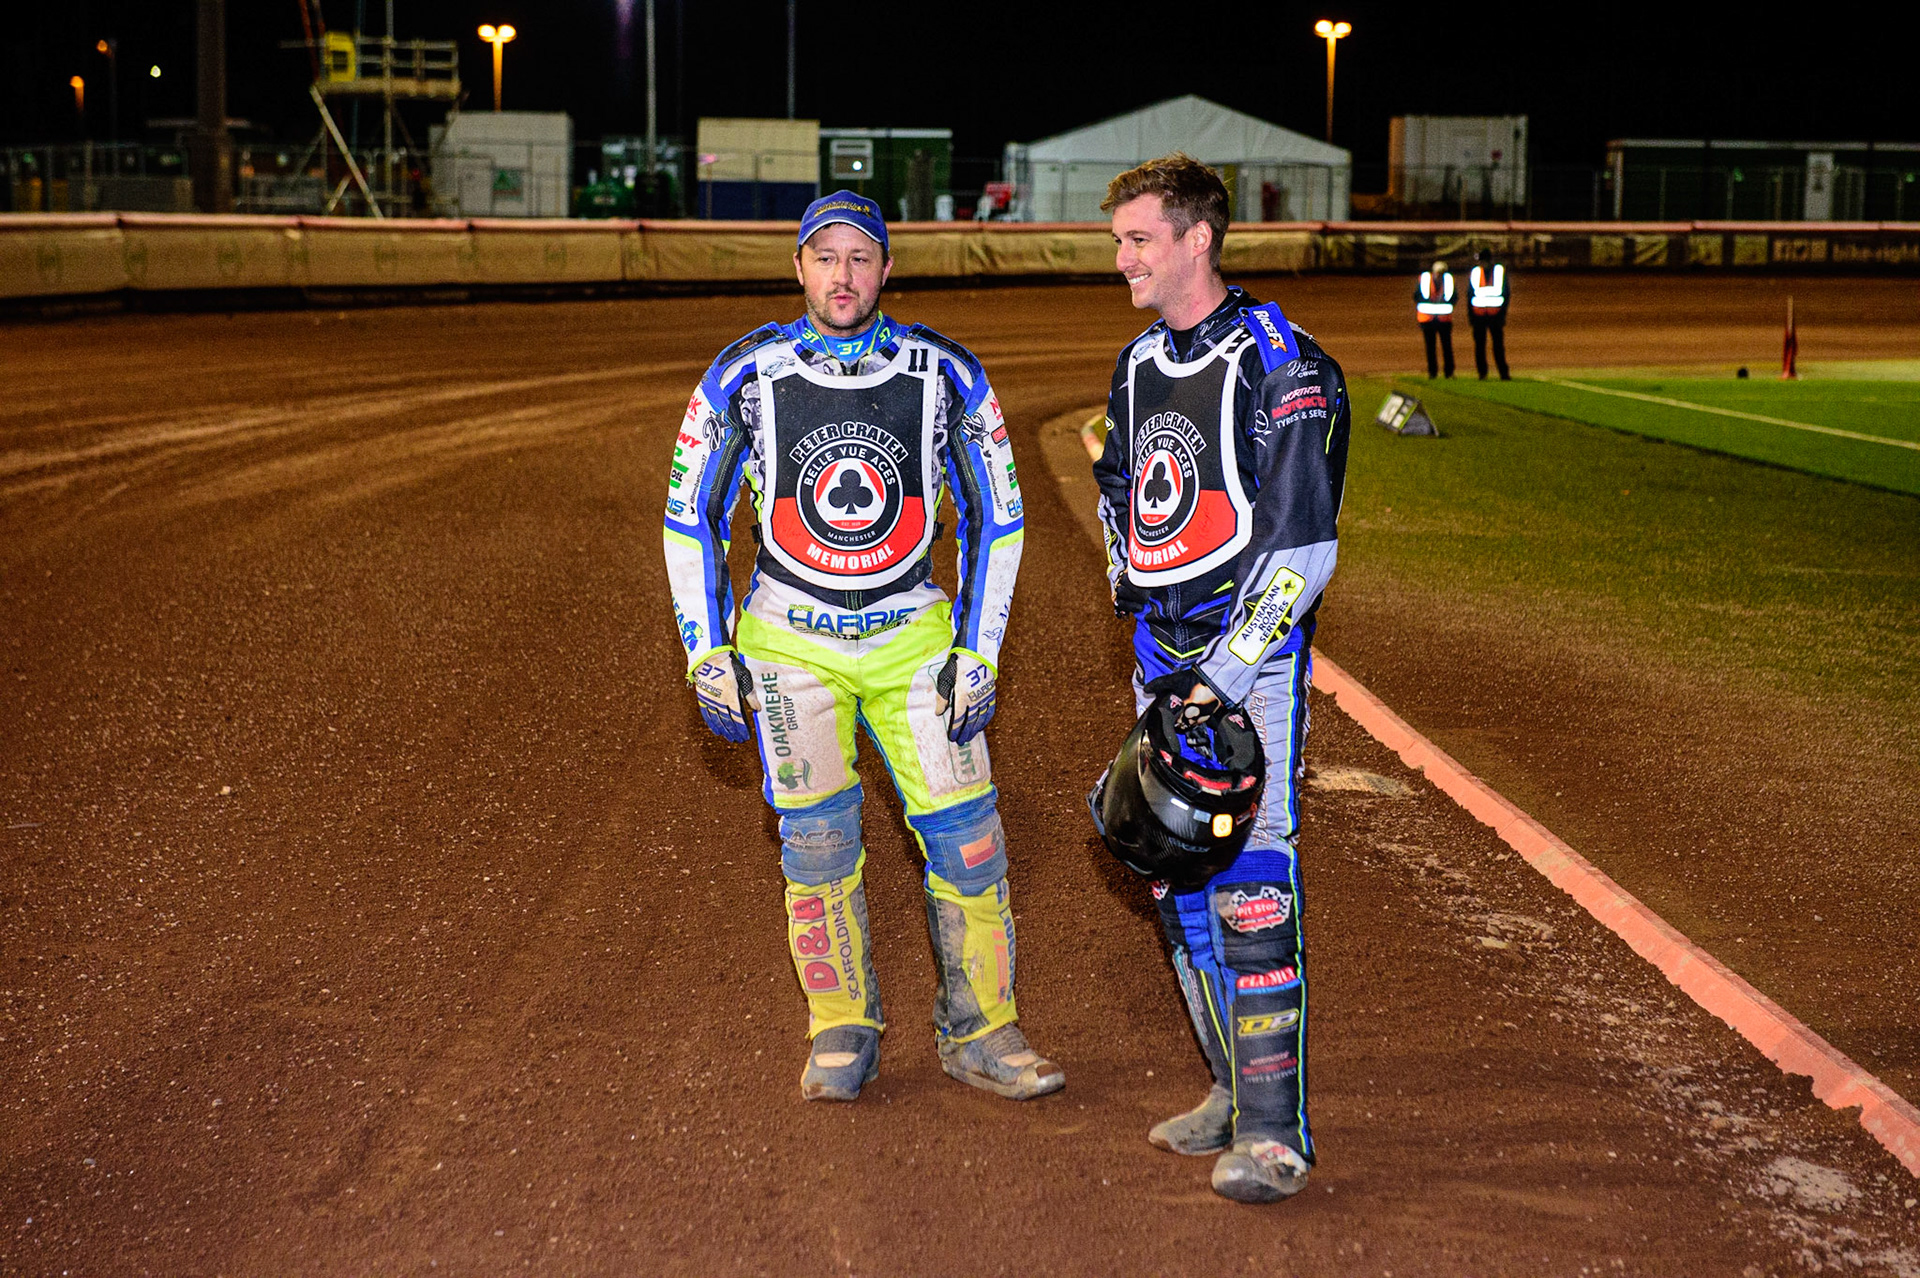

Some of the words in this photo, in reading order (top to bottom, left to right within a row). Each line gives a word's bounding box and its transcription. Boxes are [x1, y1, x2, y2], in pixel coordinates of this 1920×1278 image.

[838, 341, 863, 355] 37
[908, 349, 928, 372] 11
[1134, 413, 1162, 455] PETER
[1162, 411, 1207, 455] CRAVEN
[1276, 413, 1299, 429] TYRES
[789, 424, 840, 464] PETER
[841, 421, 909, 463] CRAVEN
[1157, 438, 1175, 451] VUE
[1174, 447, 1193, 478] ACES
[803, 451, 835, 486] BELLE
[839, 446, 868, 459] VUE
[870, 455, 896, 485] ACES
[827, 531, 876, 542] MANCHESTER
[806, 543, 895, 570] MEMORIAL
[1241, 585, 1281, 641] AUSTRALIAN
[1258, 603, 1278, 631] ROAD
[1259, 600, 1289, 643] SERVICES
[698, 662, 726, 680] 37
[966, 664, 988, 688] 37
[762, 672, 792, 757] OAKMERE
[783, 696, 798, 730] GROUP
[1237, 906, 1253, 917] Pit
[1255, 902, 1279, 914] Stop
[832, 900, 862, 1001] SCAFFOLDING
